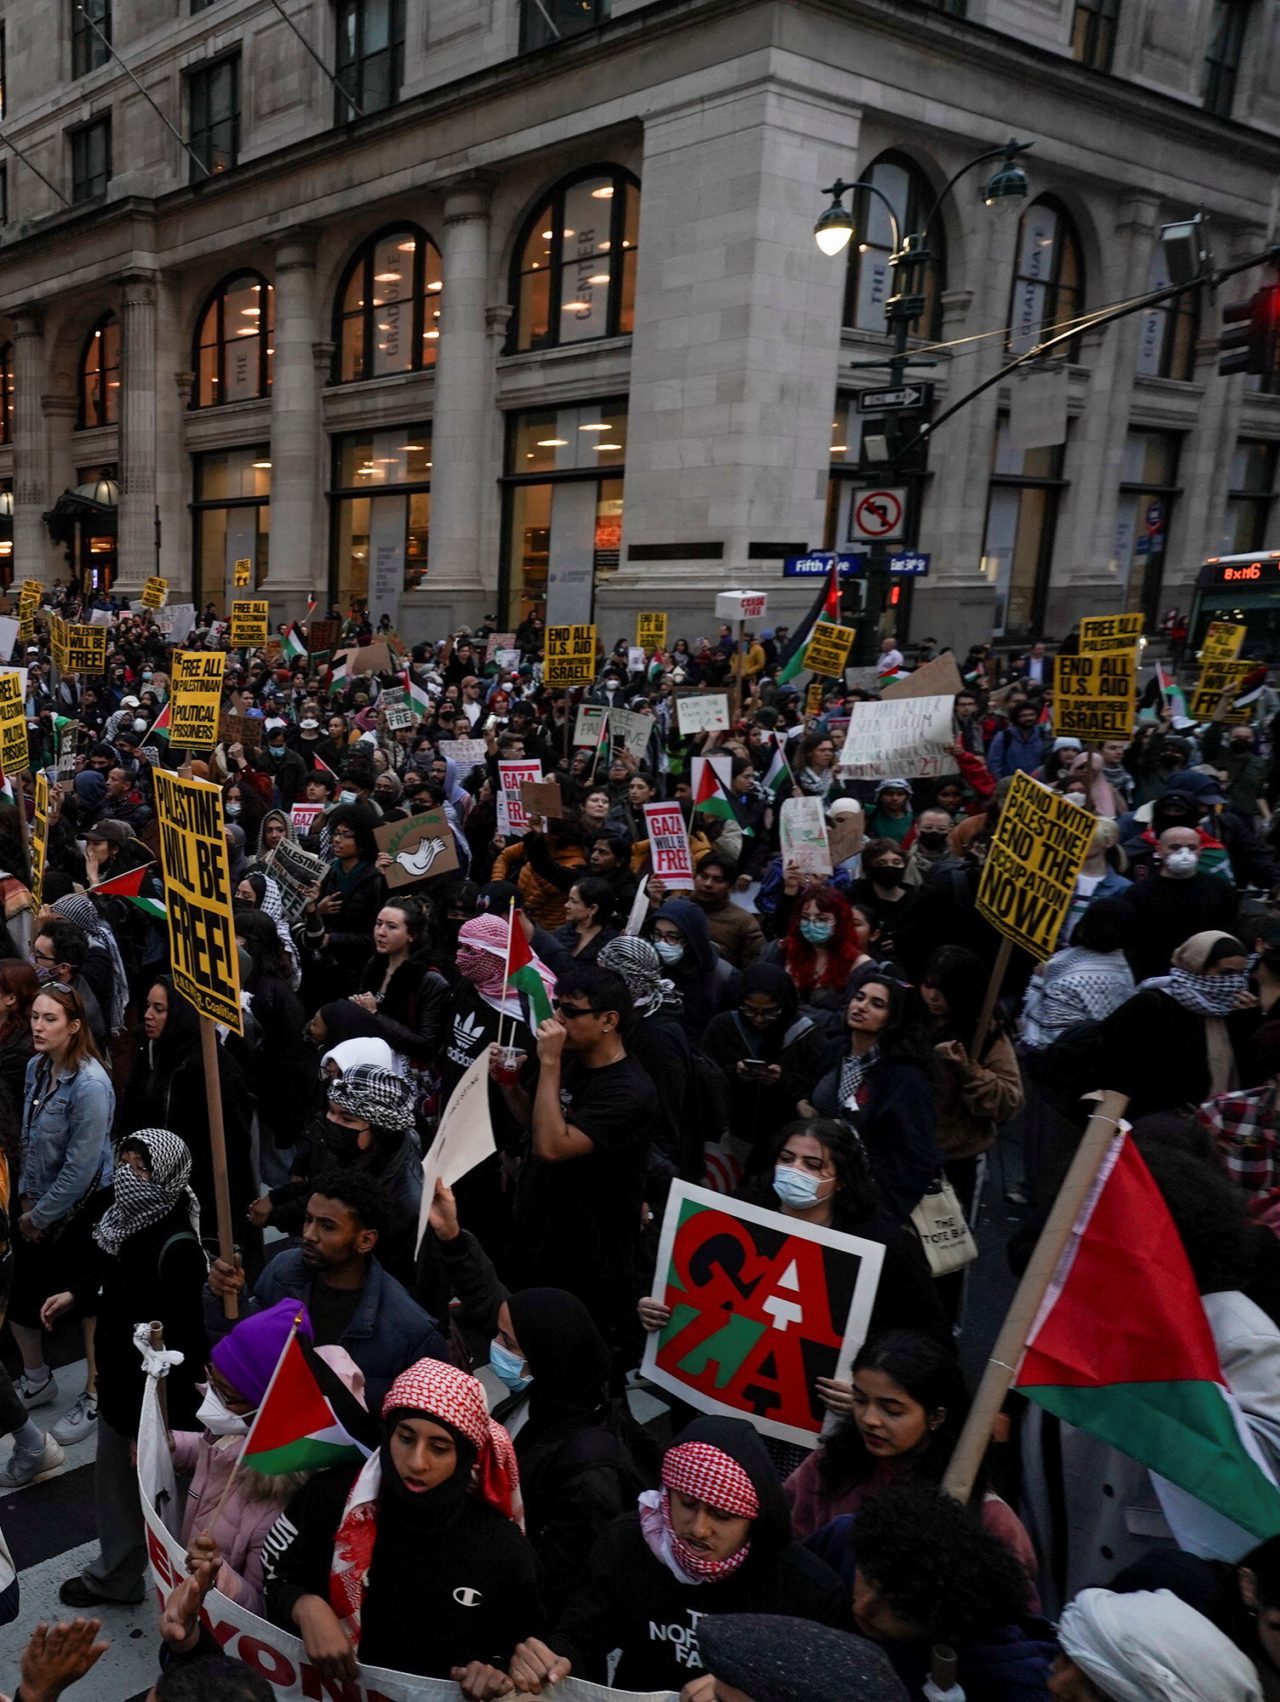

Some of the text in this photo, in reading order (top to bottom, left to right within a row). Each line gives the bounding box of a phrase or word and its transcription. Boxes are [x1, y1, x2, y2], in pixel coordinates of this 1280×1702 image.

[576, 227, 595, 321] CENTER
[871, 263, 885, 305] THE
[386, 253, 402, 357] GRADUATE
[236, 354, 247, 386] THE
[795, 559, 850, 572] Fifth Ave
[233, 602, 266, 613] FREE ALL
[69, 626, 105, 636] PALESTINE
[548, 626, 593, 642] END ALL
[816, 625, 852, 642] FREE ALL
[1085, 617, 1139, 638] FREE ALL
[70, 636, 104, 649] WILL BE
[548, 641, 592, 656] U.S. AID
[70, 651, 103, 667] FREE!
[181, 659, 203, 677] FREE
[204, 657, 222, 677] ALL
[1061, 657, 1131, 678] END ALL
[548, 666, 590, 680] ISRAEL!
[178, 679, 220, 693] PALESTINIAN
[1060, 677, 1129, 696] U.S. AID
[176, 704, 216, 723] POLITICAL
[389, 713, 411, 726] FRE
[1061, 711, 1126, 731] ISRAEL!
[173, 725, 214, 739] PRISONERS
[155, 775, 222, 841] PALESTINE
[1012, 774, 1096, 837] STAND WITH
[650, 815, 682, 836] GAZA
[1005, 795, 1087, 861] PALESTINE!
[655, 835, 686, 850] WILL BE
[998, 814, 1079, 889] END THE
[160, 823, 228, 905] WILL BE
[279, 841, 325, 874] PALESTINE
[657, 849, 689, 872] FREE
[990, 844, 1068, 911] OCCUPATION
[981, 863, 1060, 948] NOW!
[168, 887, 236, 1003] FREE!
[934, 1217, 955, 1229] THE
[921, 1231, 950, 1244] TOTE
[648, 1619, 700, 1651] NOR
[674, 1643, 704, 1669] FA
